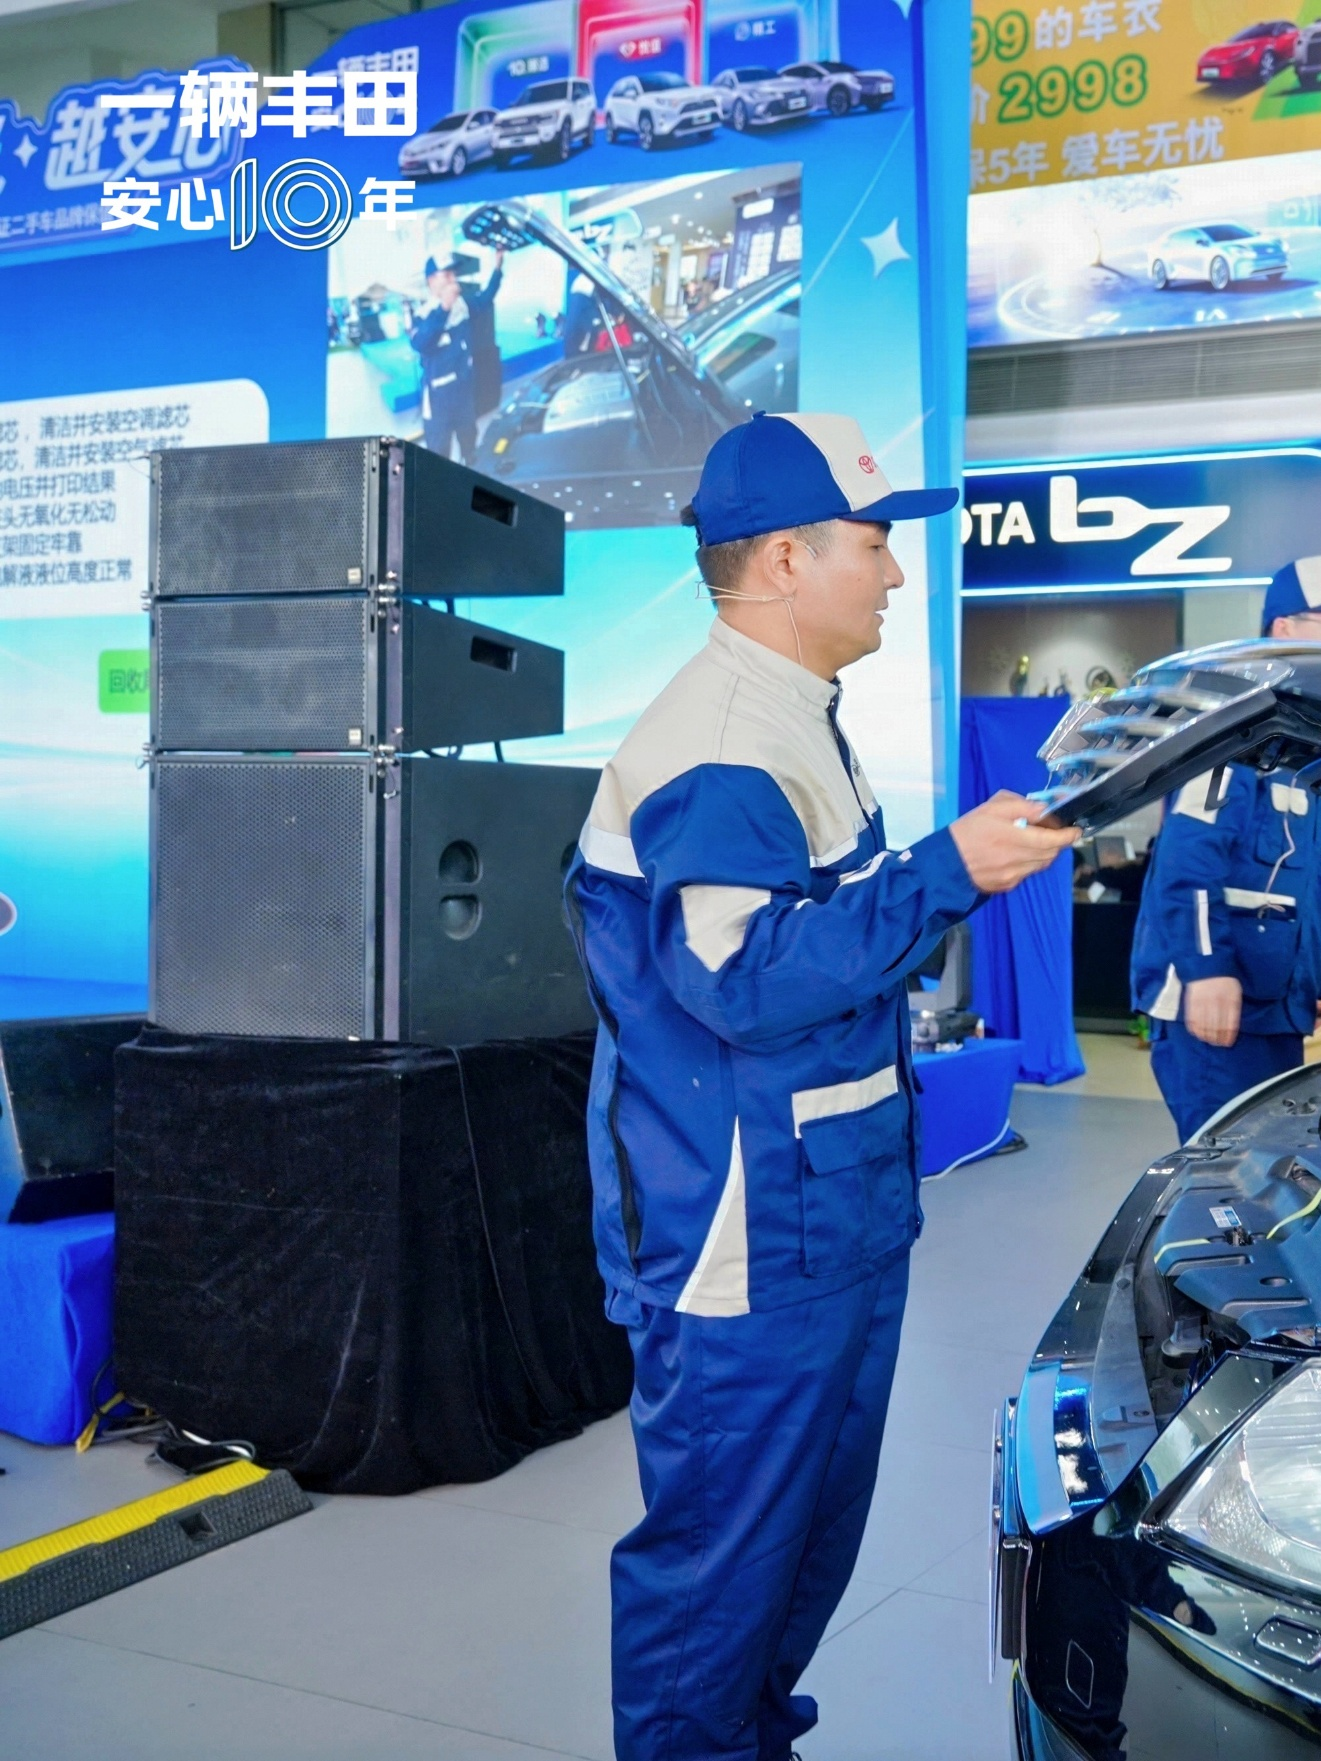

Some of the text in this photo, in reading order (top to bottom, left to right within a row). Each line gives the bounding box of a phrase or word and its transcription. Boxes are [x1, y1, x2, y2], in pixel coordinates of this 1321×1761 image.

[1062, 117, 1224, 177] 爱车无忧
[0, 469, 116, 499] 电压并打印结果
[1050, 475, 1232, 576] bz
[0, 558, 132, 587] 解液液位高度正常
[109, 668, 149, 694] 回收
